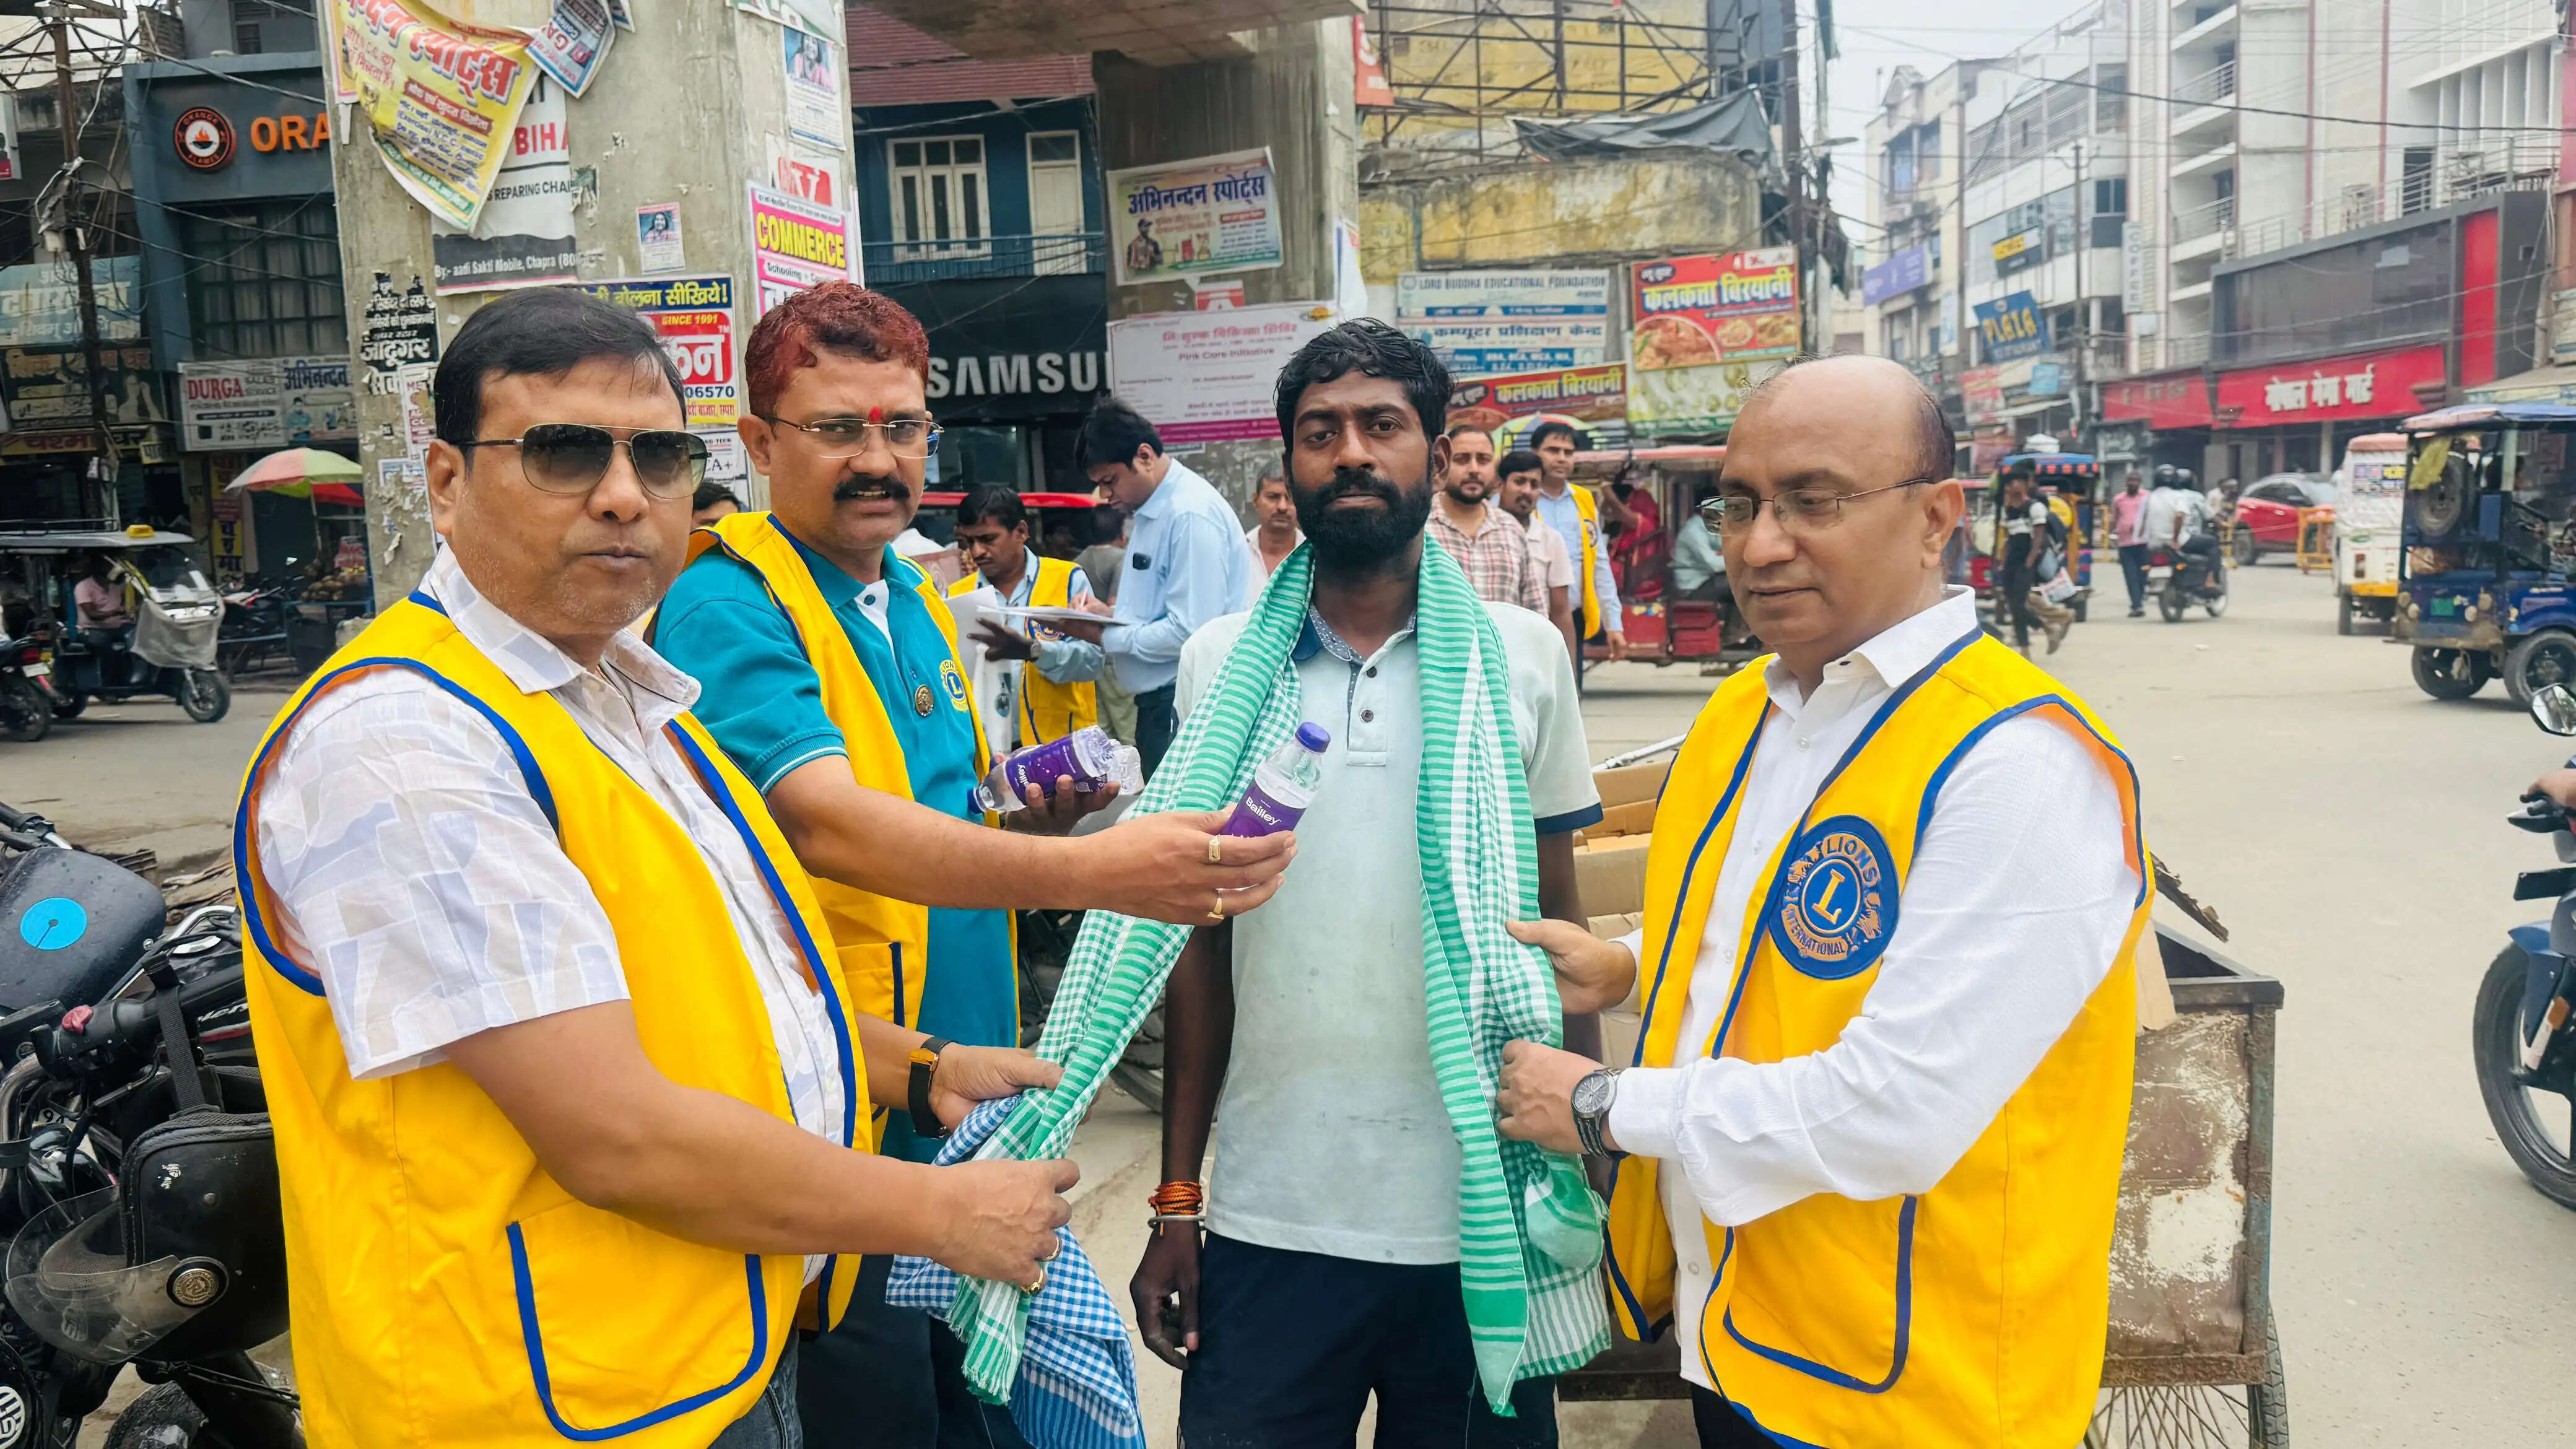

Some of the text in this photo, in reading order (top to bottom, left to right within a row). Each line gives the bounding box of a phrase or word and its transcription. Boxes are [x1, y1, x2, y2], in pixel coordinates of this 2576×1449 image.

[1128, 185, 1208, 214] अभिनन्दन
[756, 211, 848, 271] COMMERCE
[526, 256, 556, 271] Chapra
[767, 262, 802, 282] Schooling
[2128, 231, 2141, 303] COFFEE
[666, 281, 728, 306] सीखिये!
[1419, 276, 1606, 290] LORD BUDDHA EDUCATIONAL FOUNDATION
[661, 315, 718, 325] SINCE 1991
[718, 324, 730, 333] TM
[360, 337, 431, 368] जादूगर
[1179, 347, 1275, 362] Pink Care Initiative
[926, 351, 1113, 398] SAMSU
[187, 376, 245, 400] DURGA
[948, 676, 963, 695] L
[1245, 796, 1281, 825] Bailley
[1826, 836, 1878, 882] LIONS
[1811, 868, 1846, 925] L
